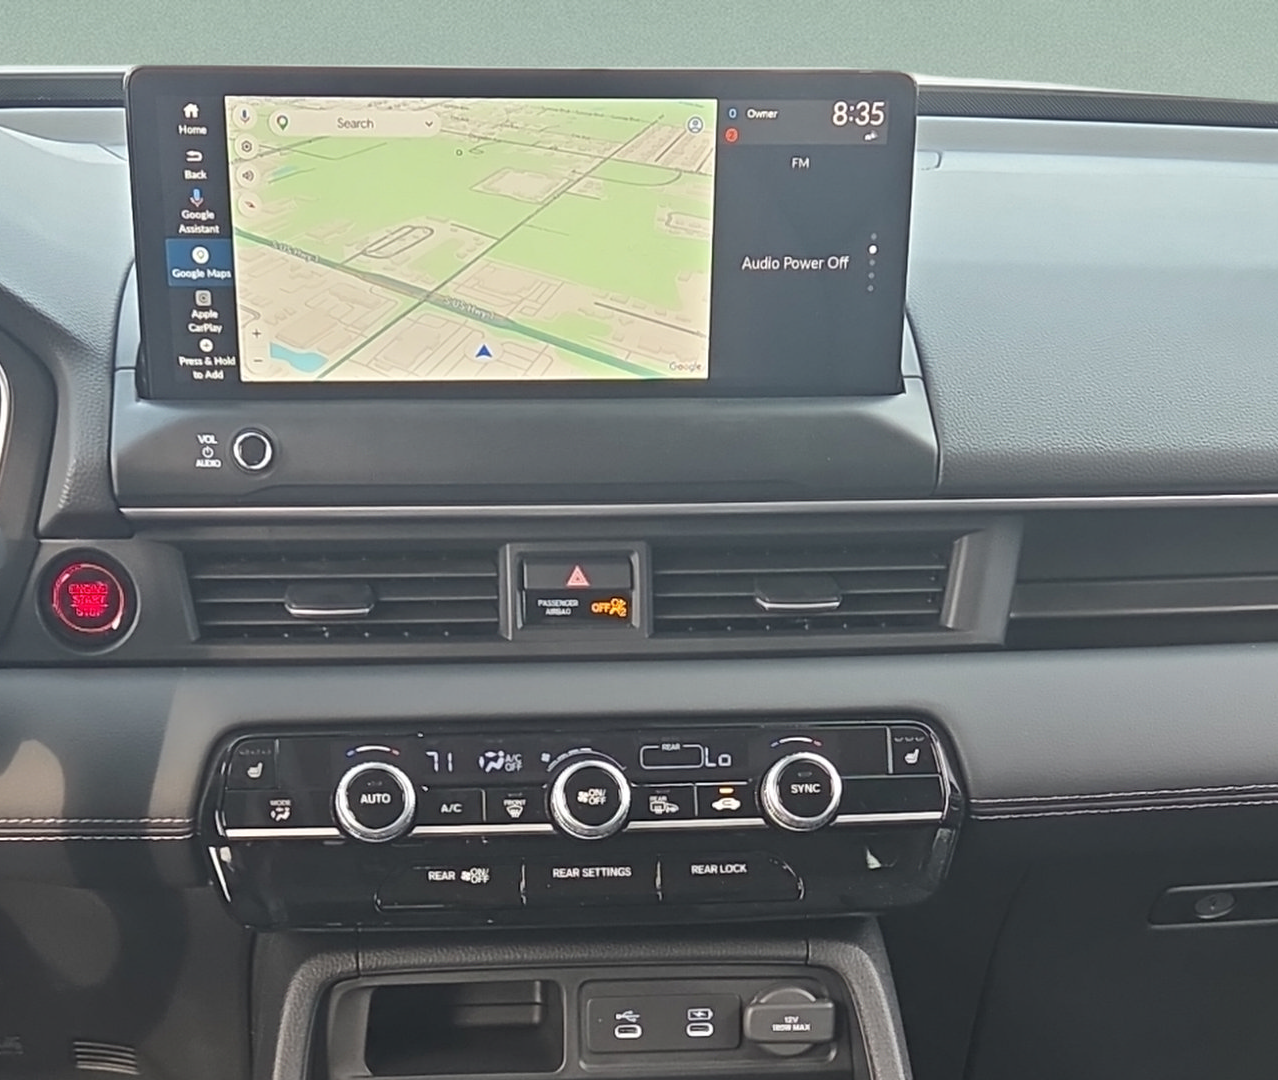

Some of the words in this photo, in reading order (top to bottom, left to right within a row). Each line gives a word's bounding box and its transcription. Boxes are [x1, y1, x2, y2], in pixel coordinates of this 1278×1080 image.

[746, 108, 779, 119] Owner
[832, 101, 885, 126] 8:35
[336, 117, 374, 129] Search
[178, 124, 208, 136] Home
[791, 157, 810, 169] FM
[184, 169, 208, 180] Back
[181, 209, 215, 222] Google
[178, 223, 220, 235] Assistant
[741, 256, 781, 270] Audio
[783, 257, 824, 270] Power
[827, 255, 850, 270] Off
[171, 268, 205, 280] Google
[206, 268, 232, 280] Maps
[190, 309, 219, 321] Apple
[187, 322, 223, 334] CarPlay
[178, 356, 203, 367] Press
[204, 356, 212, 367] &
[212, 355, 236, 366] Hold
[668, 361, 703, 373] Google
[192, 370, 203, 380] to
[204, 369, 224, 380] Add
[197, 434, 218, 445] VOL
[195, 459, 222, 468] AUDIO
[537, 599, 580, 608] PASSENGER
[590, 602, 611, 614] OFF
[661, 743, 681, 752] REAR
[425, 750, 454, 773] 71
[504, 753, 522, 764] A/C
[704, 747, 732, 768] Lo
[504, 763, 523, 773] OFF
[790, 782, 821, 795] SYNC
[359, 792, 392, 805] AUTO
[503, 799, 527, 807] FRONT
[587, 796, 608, 807] OFF
[440, 803, 463, 815] A/C
[552, 867, 580, 879] REAR
[582, 866, 632, 879] SETTINGS
[691, 864, 719, 875] REAR
[720, 862, 748, 875] LOCK
[427, 870, 456, 882] REAR
[470, 875, 491, 885] OFF
[784, 1015, 799, 1023] 12V
[792, 1023, 811, 1032] MAX
